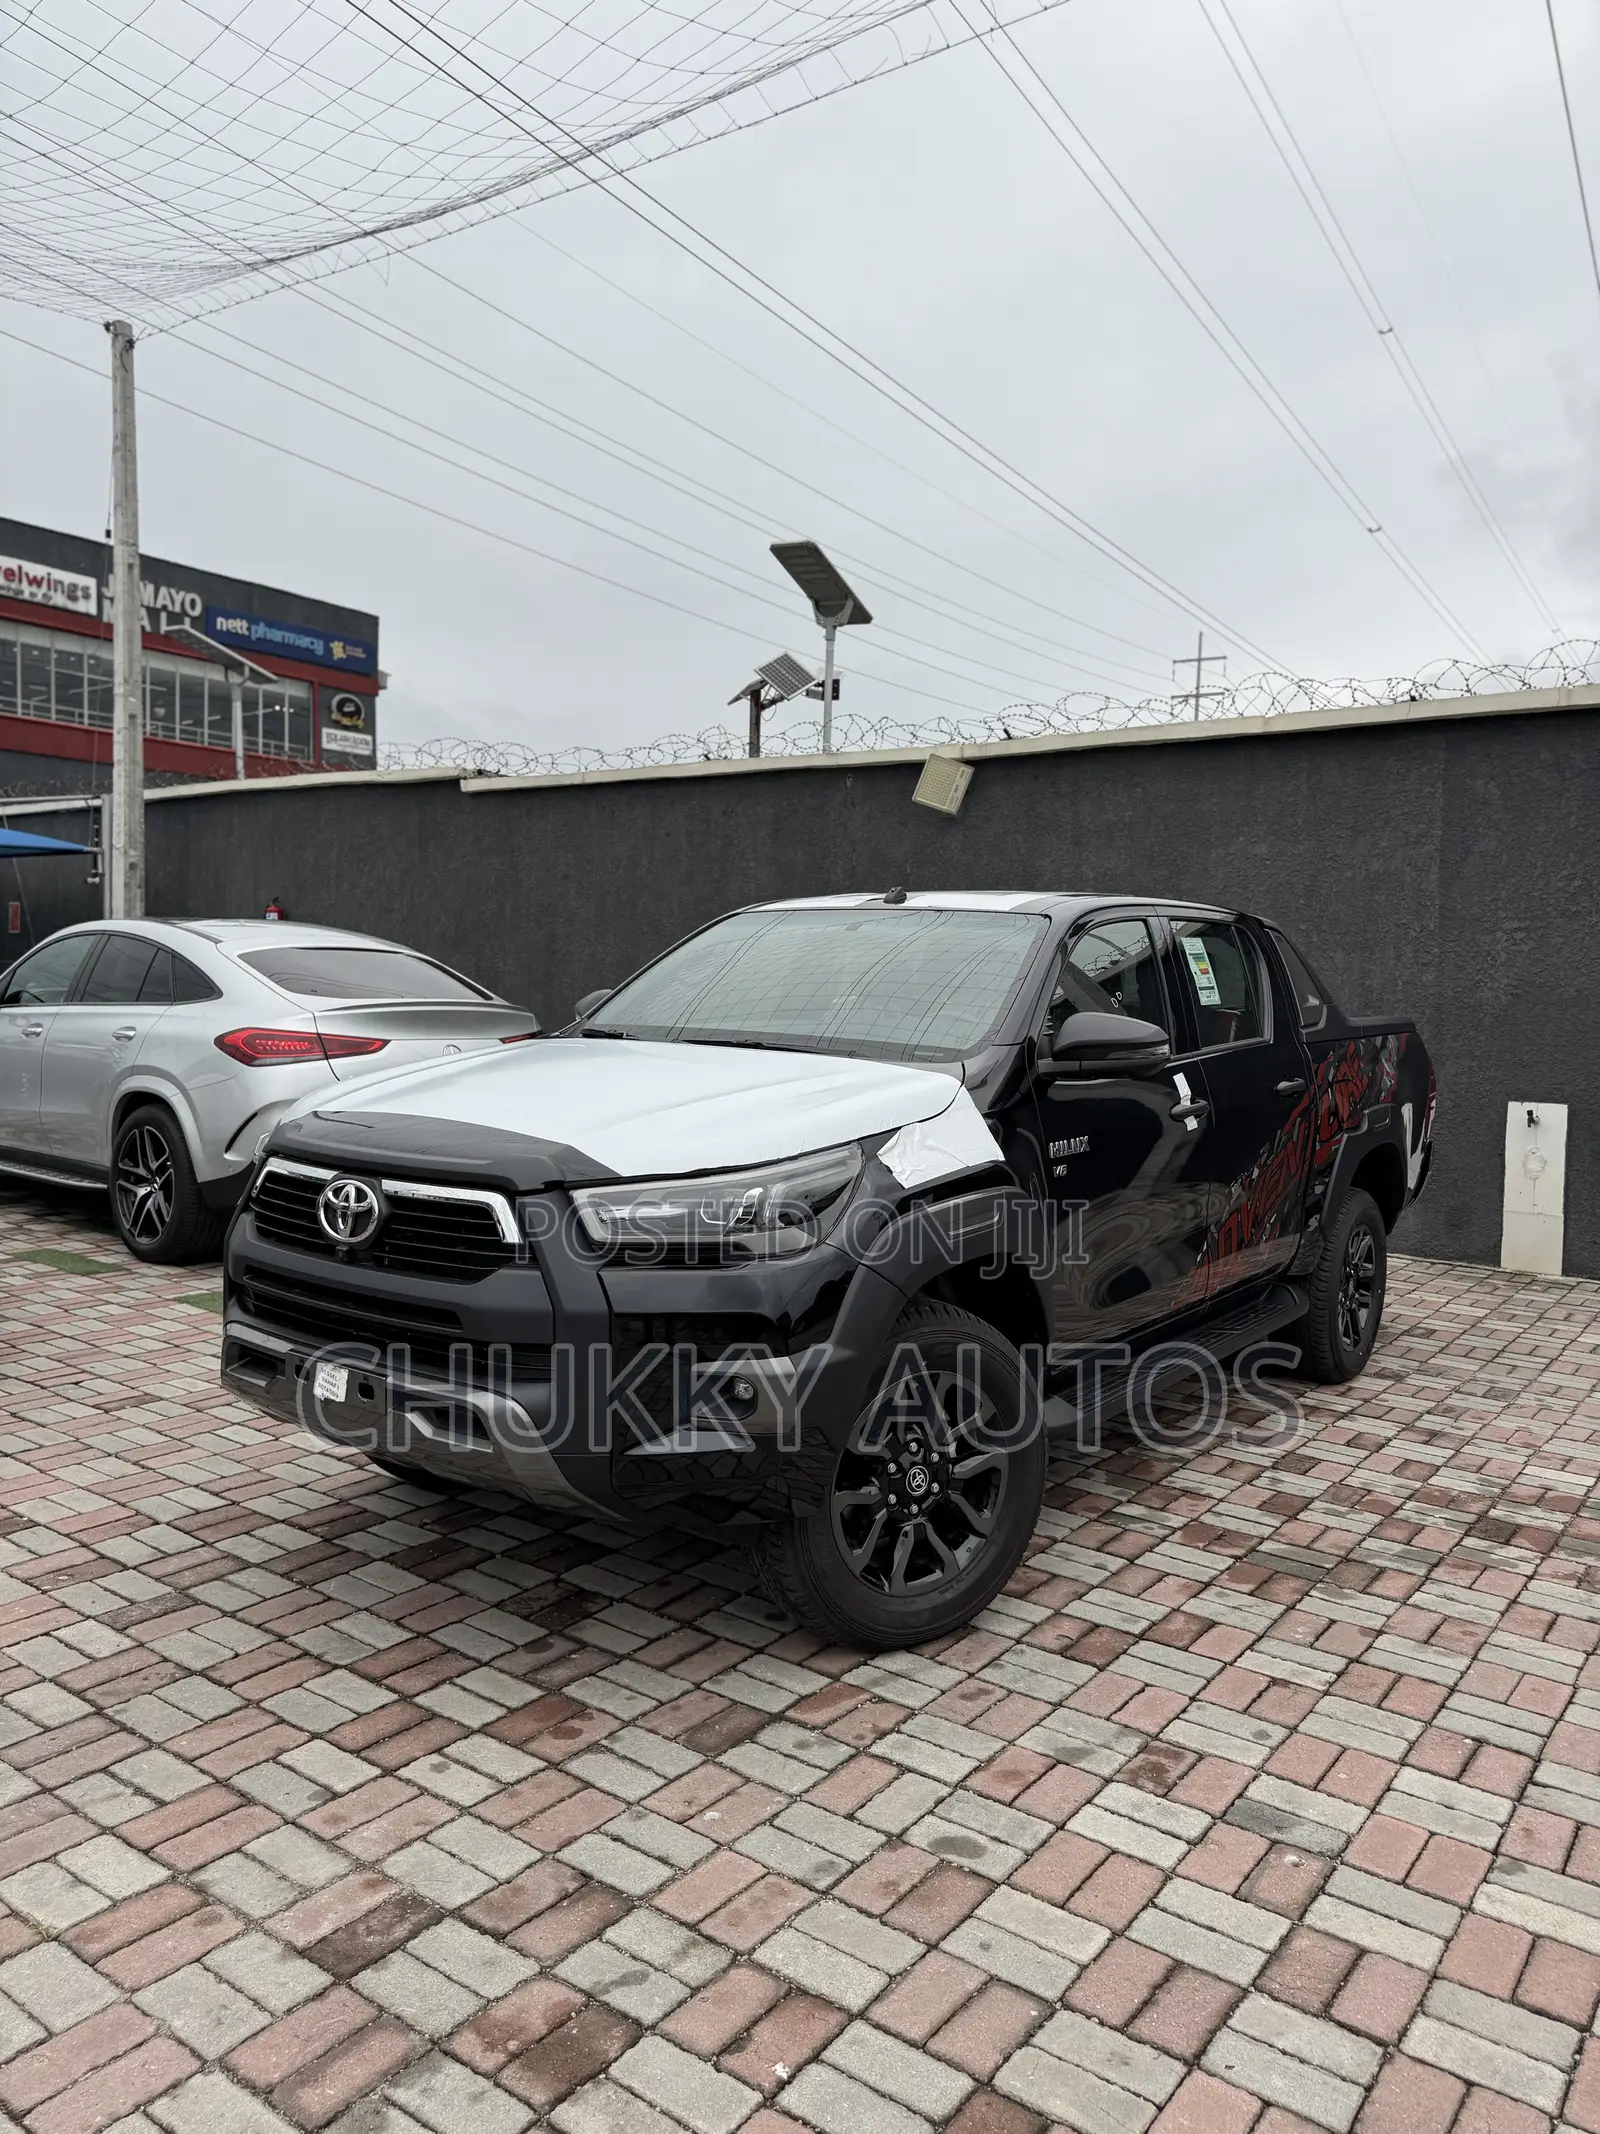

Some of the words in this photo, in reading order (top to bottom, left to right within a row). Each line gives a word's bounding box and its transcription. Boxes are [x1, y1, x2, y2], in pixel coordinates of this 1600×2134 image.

[101, 573, 202, 617] JMAYO
[216, 616, 250, 636] nett
[250, 621, 324, 656] pharmacy
[1049, 1136, 1090, 1158] HILUX
[1053, 1164, 1068, 1177] V6
